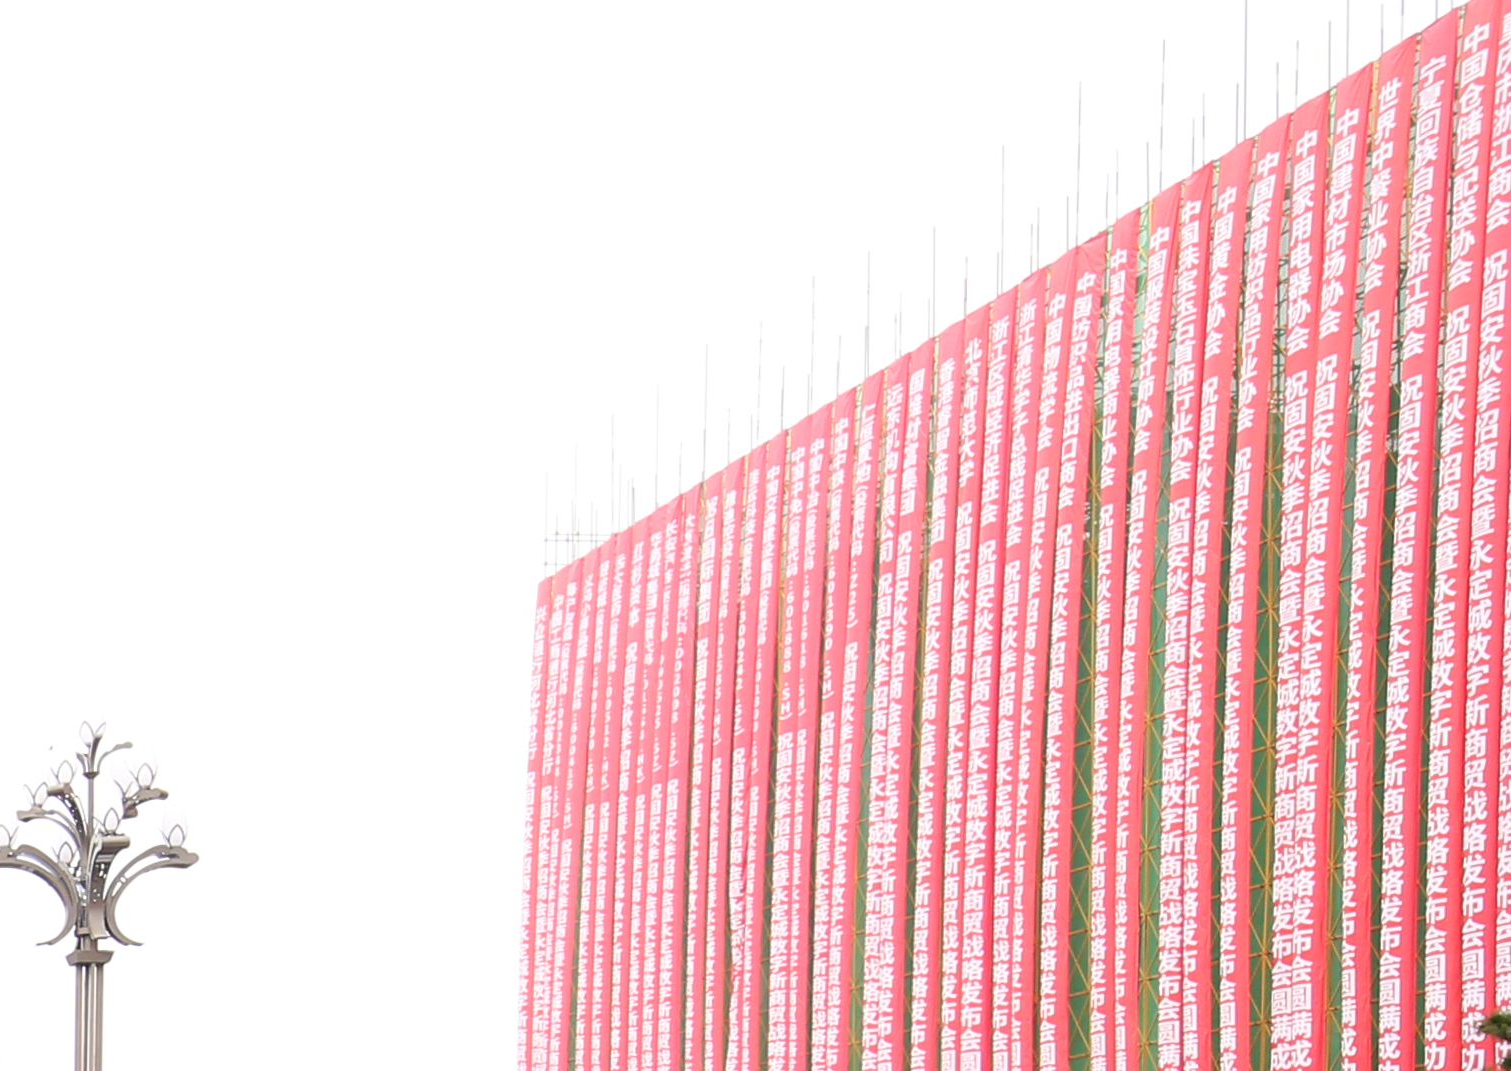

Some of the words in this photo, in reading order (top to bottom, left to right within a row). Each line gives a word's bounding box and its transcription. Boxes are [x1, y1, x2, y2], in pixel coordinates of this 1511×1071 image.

[1287, 130, 1318, 356] 中国家用电器协会
[1319, 108, 1359, 339] 中国建材市场协会
[1364, 77, 1402, 291] 世界中餐业协会
[1403, 55, 1446, 358] 宁夏回族自治区浙江商会
[1447, 22, 1491, 292] 中国仓储与配送协会
[1037, 293, 1066, 451] 中国物流学会
[1101, 248, 1128, 488] 中国家用电器商业协会
[1133, 226, 1170, 455] 中国服装设计师协会
[1169, 200, 1201, 485] 中国珠宝玉石首饰行业协会
[1204, 186, 1236, 360] 中国黄金协会
[1237, 152, 1279, 432] 中国家用纺织品行业协会
[958, 338, 982, 487] 北京师范大学
[980, 315, 1009, 527] 浙江区域经济促进会
[1058, 272, 1096, 509] 中国纺织品进出口商会
[1424, 304, 1471, 1070] 祝固安秋季招商会暨永定城数字新商贸战略发布会圆满成功
